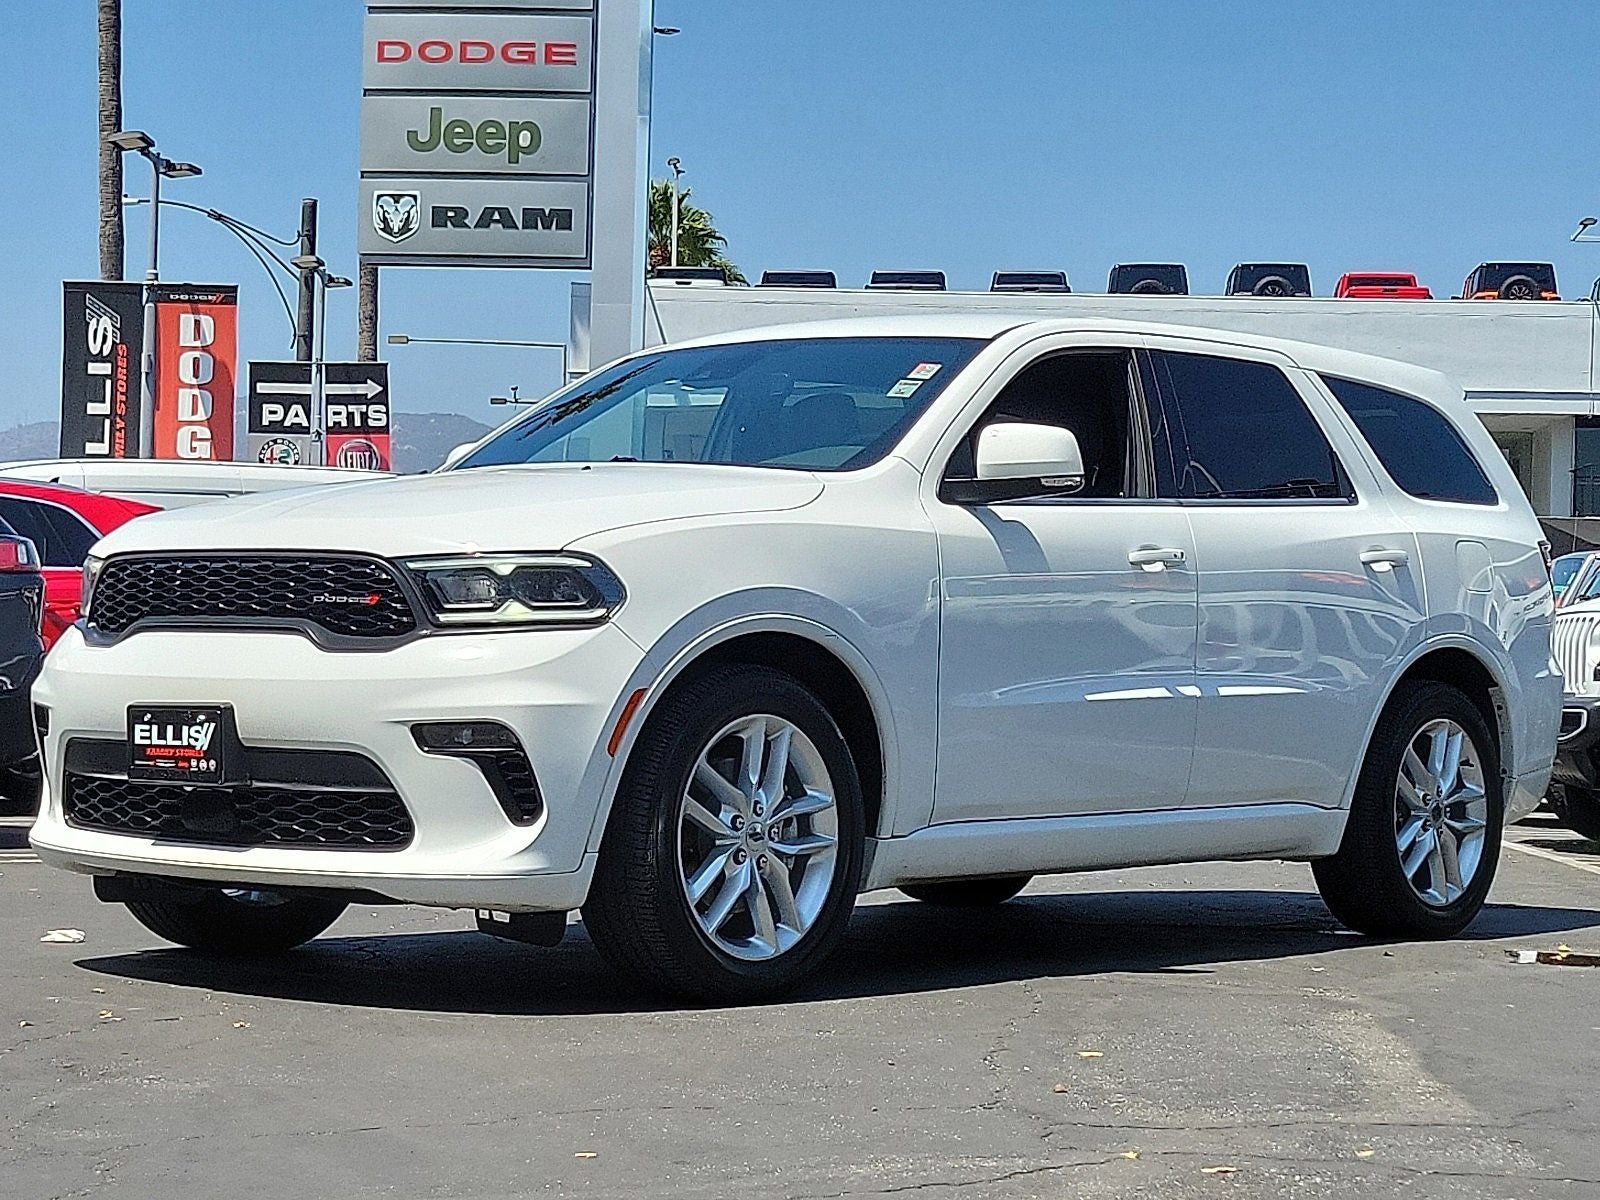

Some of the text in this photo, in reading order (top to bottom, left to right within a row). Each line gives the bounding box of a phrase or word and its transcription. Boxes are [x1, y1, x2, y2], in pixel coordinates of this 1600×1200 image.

[376, 40, 577, 66] DODGE
[406, 106, 542, 164] Jeep
[431, 205, 573, 232] RAM
[116, 343, 128, 416] STORES
[261, 403, 387, 428] PARTS
[259, 438, 299, 461] ALFA ROMEO
[346, 451, 371, 470] FIAT
[134, 723, 205, 747] ELLIS
